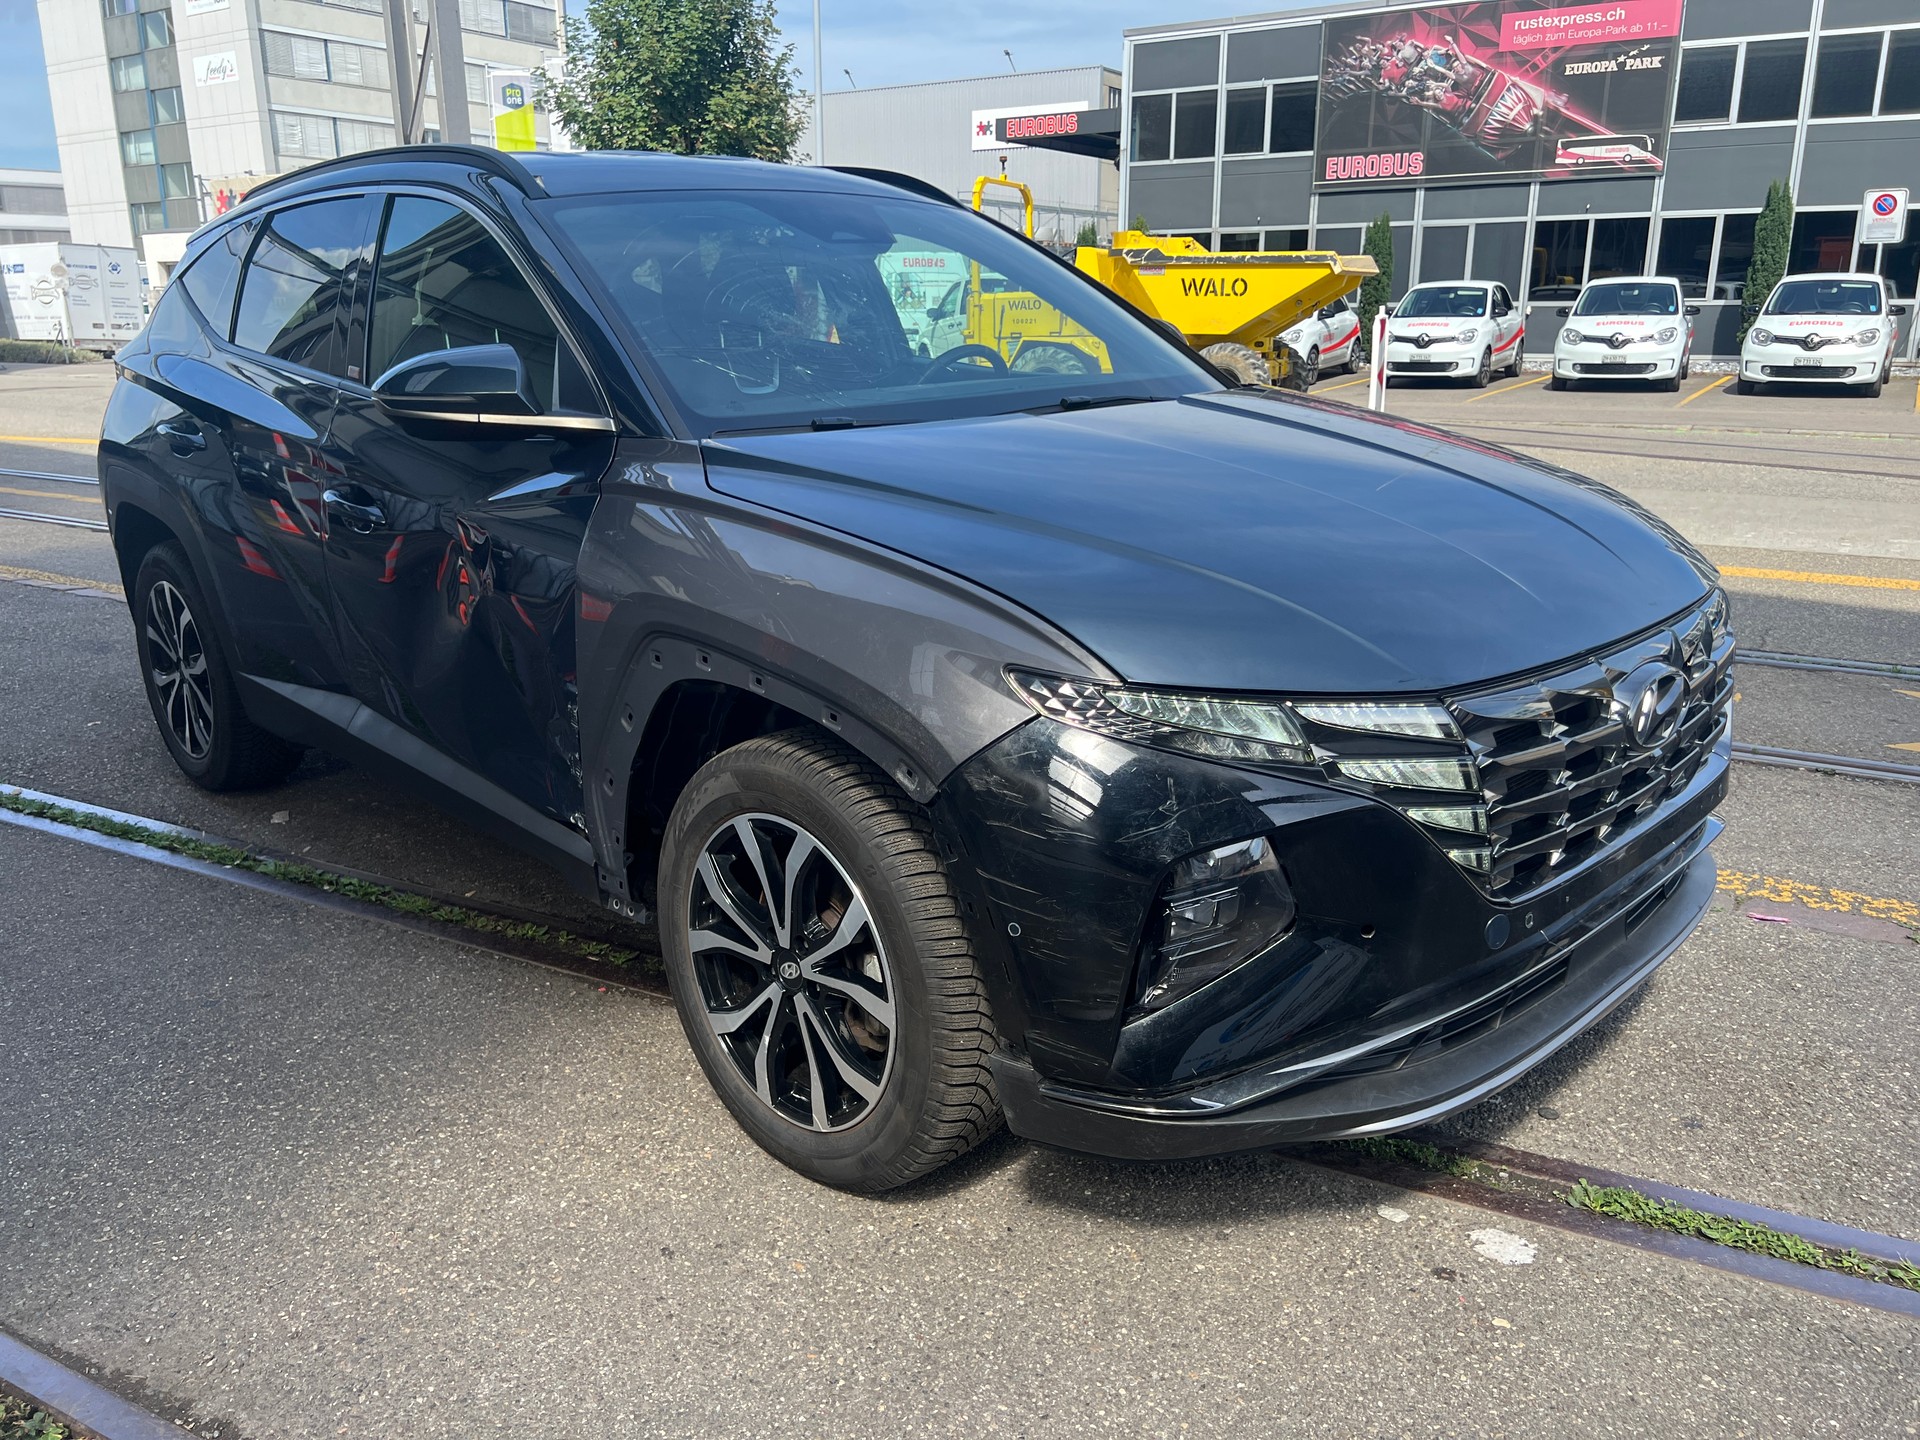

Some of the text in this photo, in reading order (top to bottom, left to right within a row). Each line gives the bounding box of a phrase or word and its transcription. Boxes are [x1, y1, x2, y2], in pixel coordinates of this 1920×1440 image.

[1514, 7, 1626, 31] rustexpress.ch
[1513, 32, 1543, 46] täglich
[1545, 32, 1566, 41] zum
[1567, 24, 1628, 39] Europa-Park
[1630, 23, 1643, 33] ab
[1563, 56, 1664, 76] EUROPA PARK
[506, 88, 521, 98] pro
[506, 97, 522, 105] one
[1006, 113, 1078, 138] EUROBUS
[1605, 146, 1630, 154] EUROBUS
[1325, 152, 1424, 180] EUROBUS
[1181, 277, 1248, 297] WALO
[1008, 299, 1042, 311] WALO
